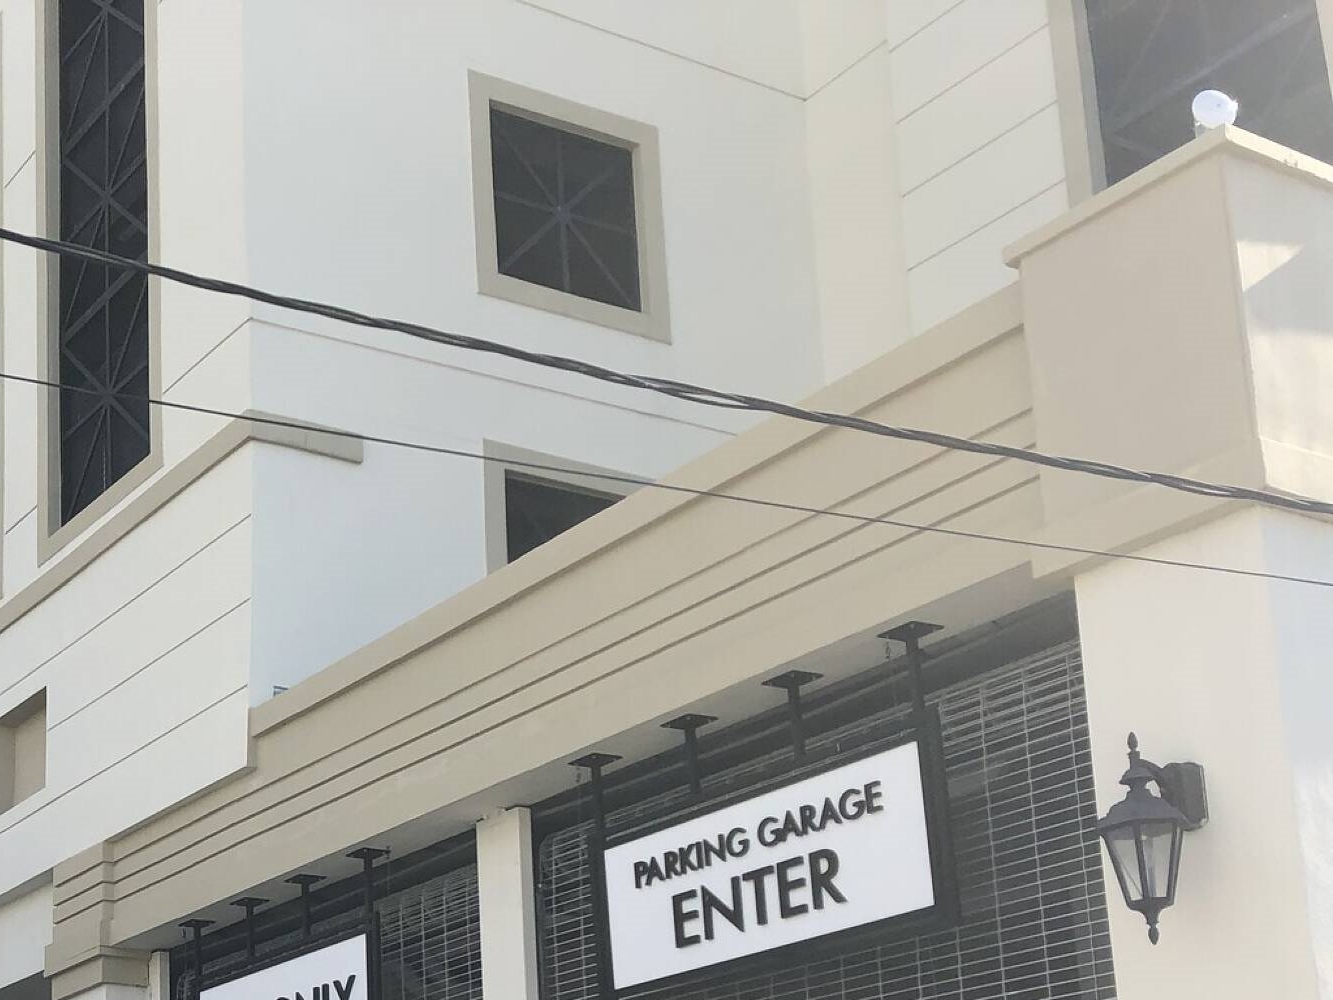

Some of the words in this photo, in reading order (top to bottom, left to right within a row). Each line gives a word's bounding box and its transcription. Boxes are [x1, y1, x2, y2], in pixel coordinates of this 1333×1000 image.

[633, 827, 750, 889] PARKING
[757, 780, 884, 847] GARAGE
[671, 848, 848, 949] ENTER
